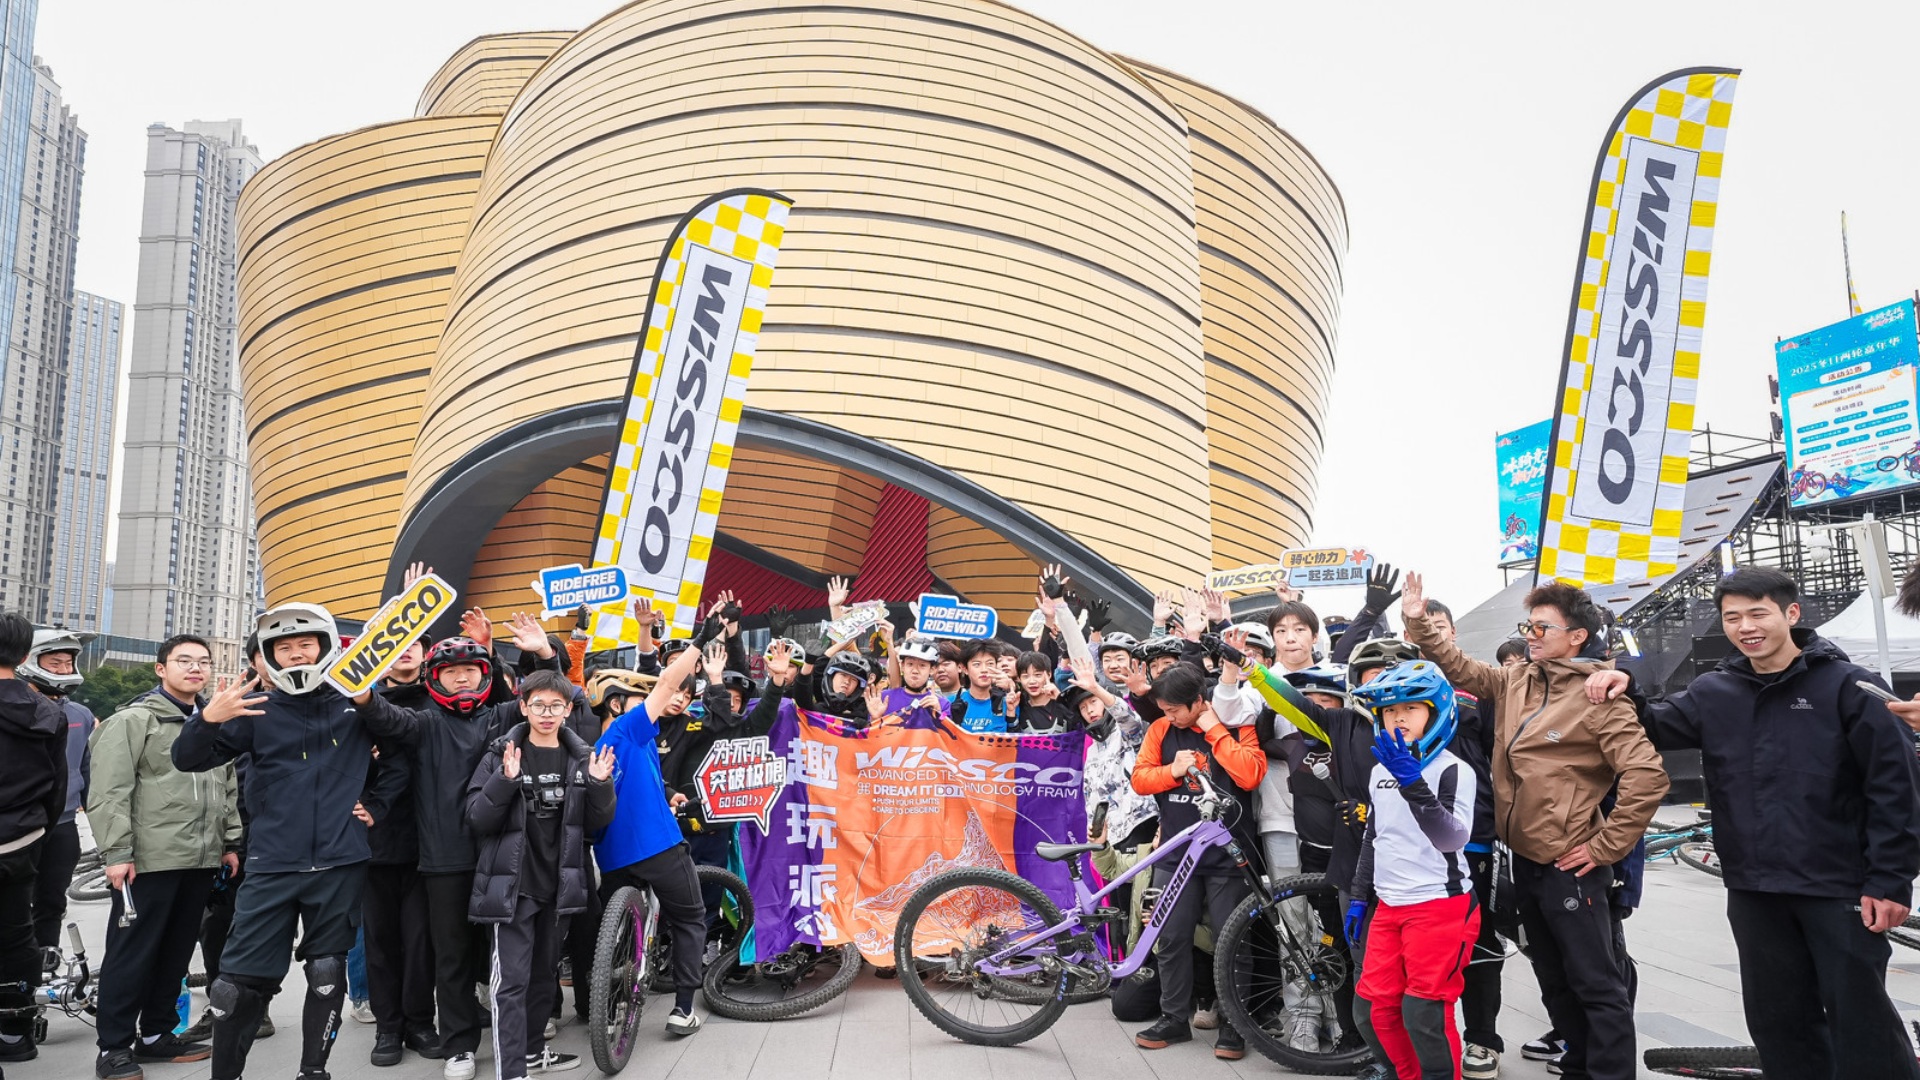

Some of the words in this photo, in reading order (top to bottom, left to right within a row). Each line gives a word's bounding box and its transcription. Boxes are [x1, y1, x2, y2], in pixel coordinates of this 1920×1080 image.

[1294, 567, 1364, 582] 一起去追风
[710, 761, 786, 795] 突破极限
[858, 769, 938, 781] ADVANCED
[873, 784, 919, 796] DREAM
[920, 784, 933, 795] IT
[915, 797, 940, 805] LIMITS
[905, 806, 940, 814] DESCEND
